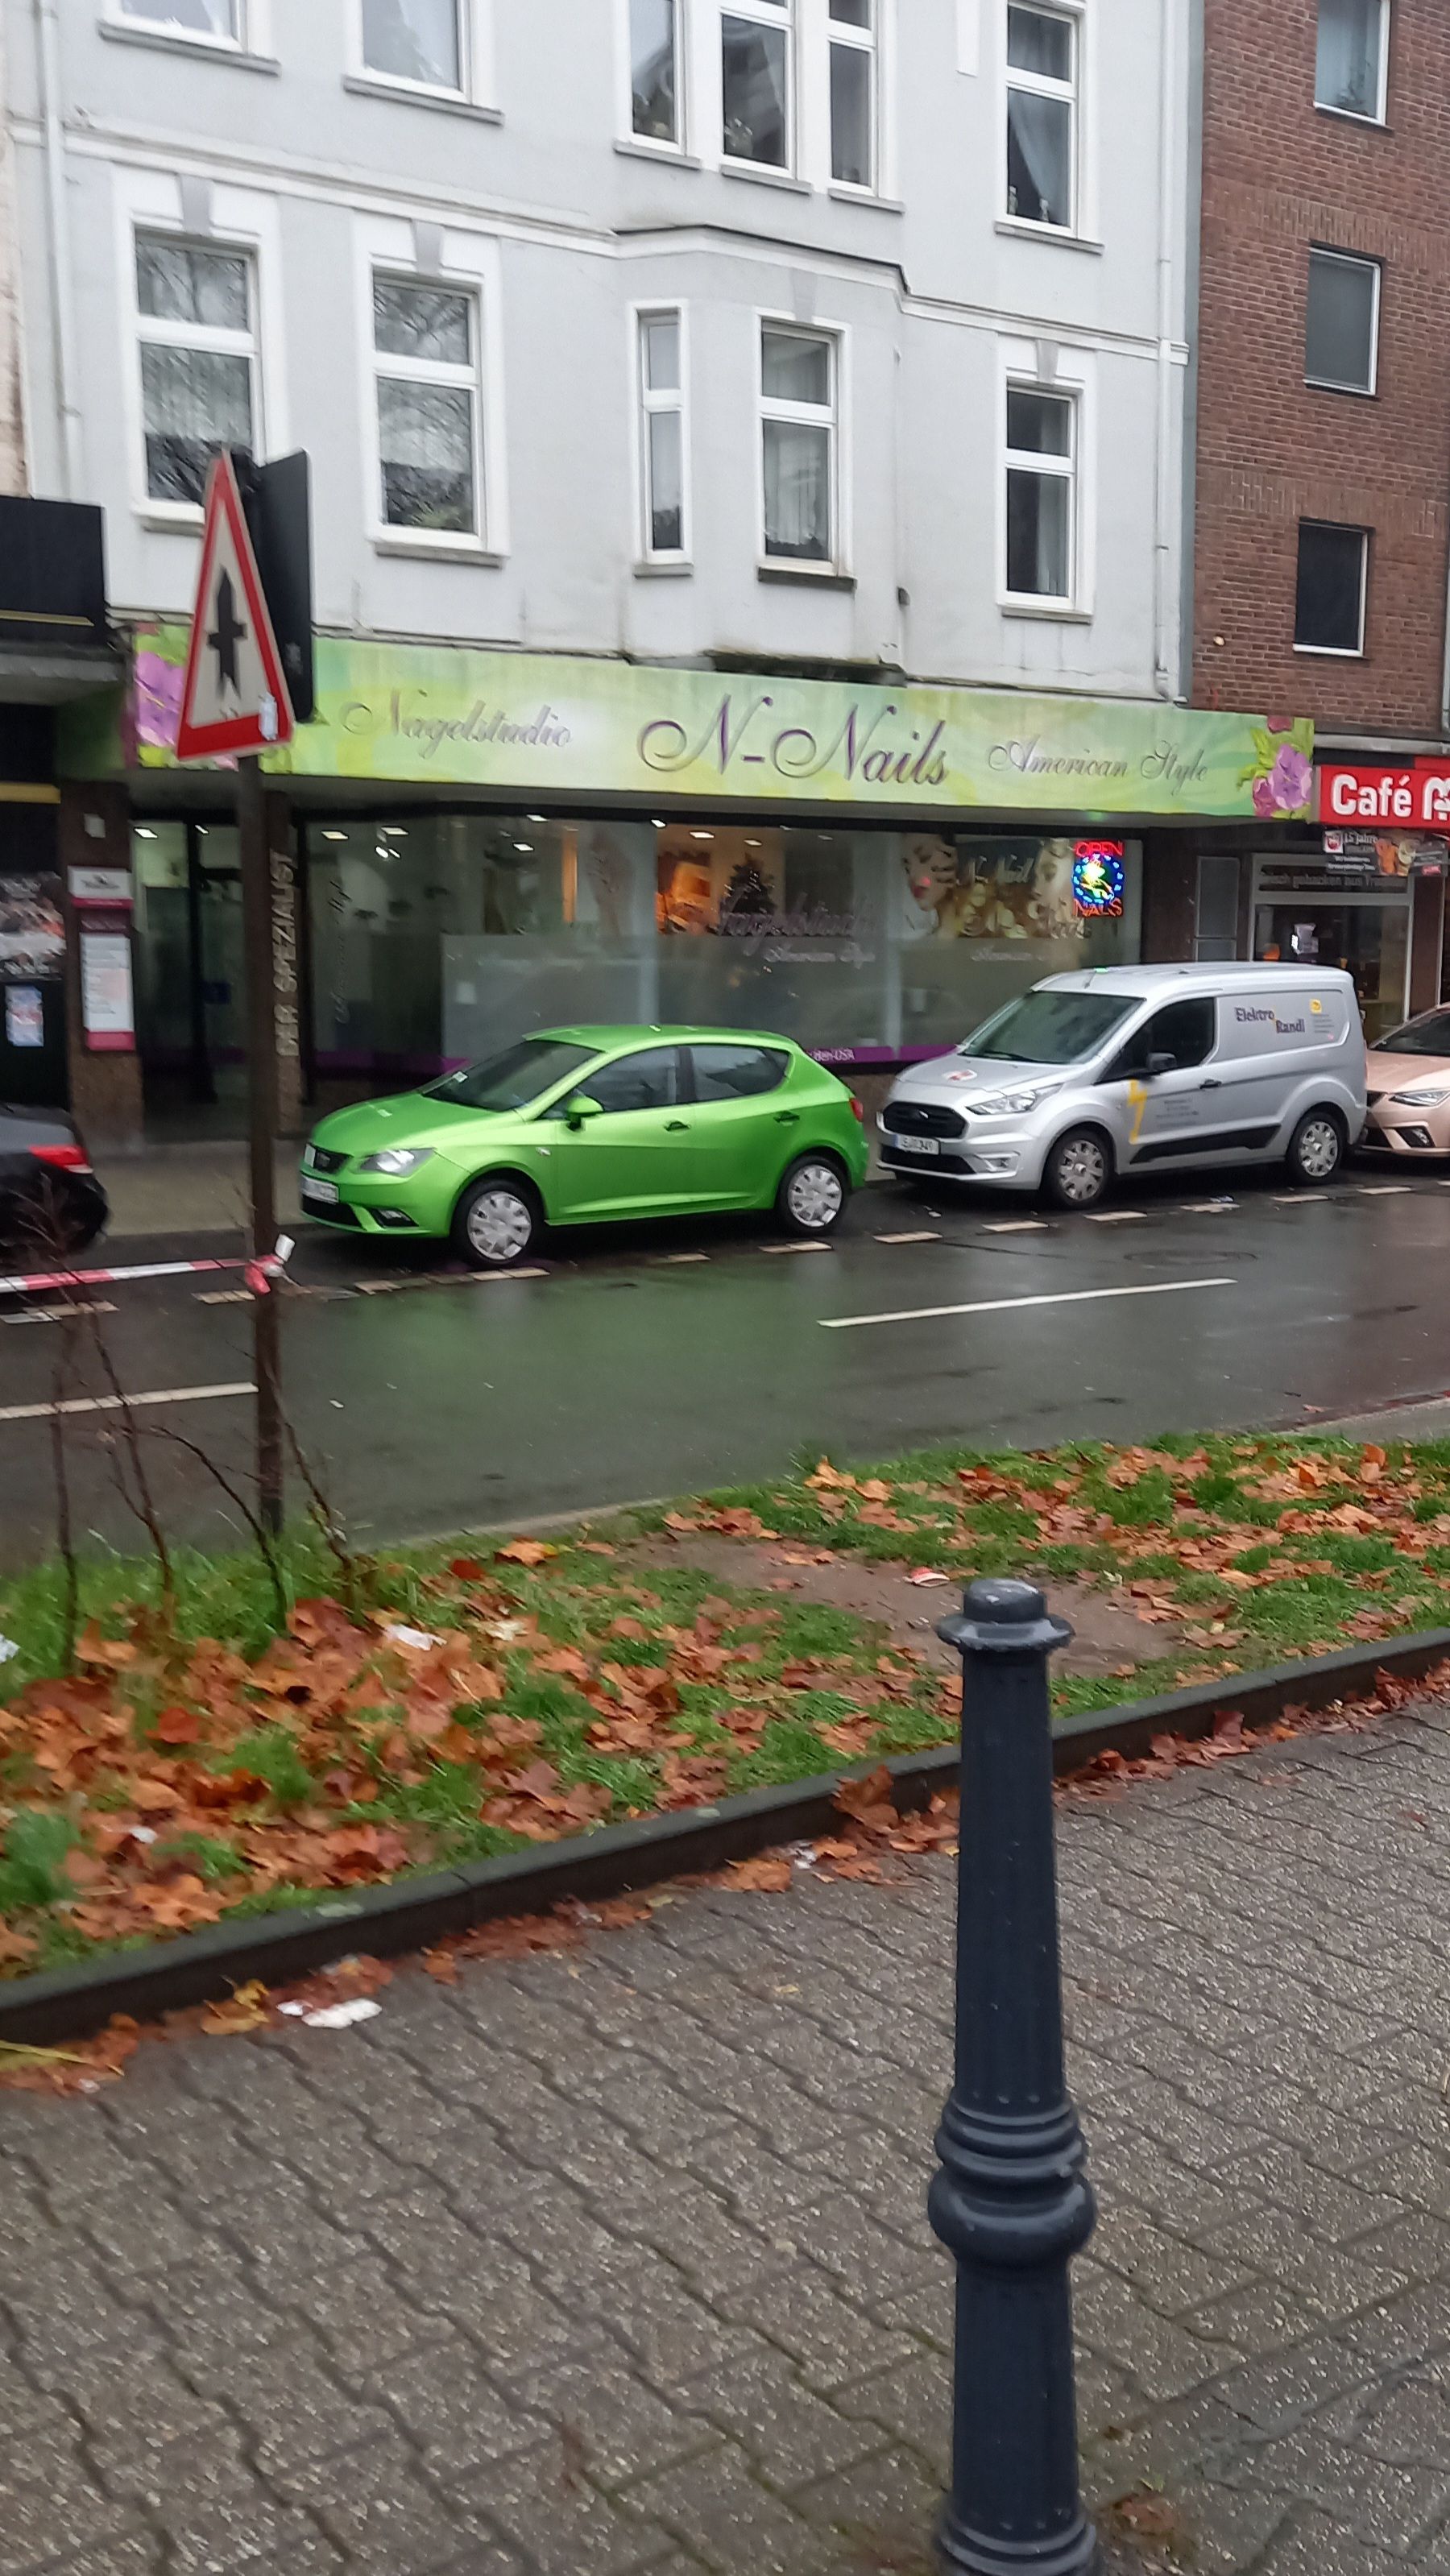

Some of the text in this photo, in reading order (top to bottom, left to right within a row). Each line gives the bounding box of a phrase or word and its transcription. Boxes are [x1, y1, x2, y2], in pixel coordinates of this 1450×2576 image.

[338, 686, 571, 759] Nagelstudio
[637, 693, 949, 785] N-Nails
[988, 734, 1208, 797] American Style
[1332, 773, 1412, 818] Café
[1075, 840, 1123, 857] OPEN
[1073, 897, 1123, 917] NAILS
[1235, 1006, 1275, 1022] Elektro
